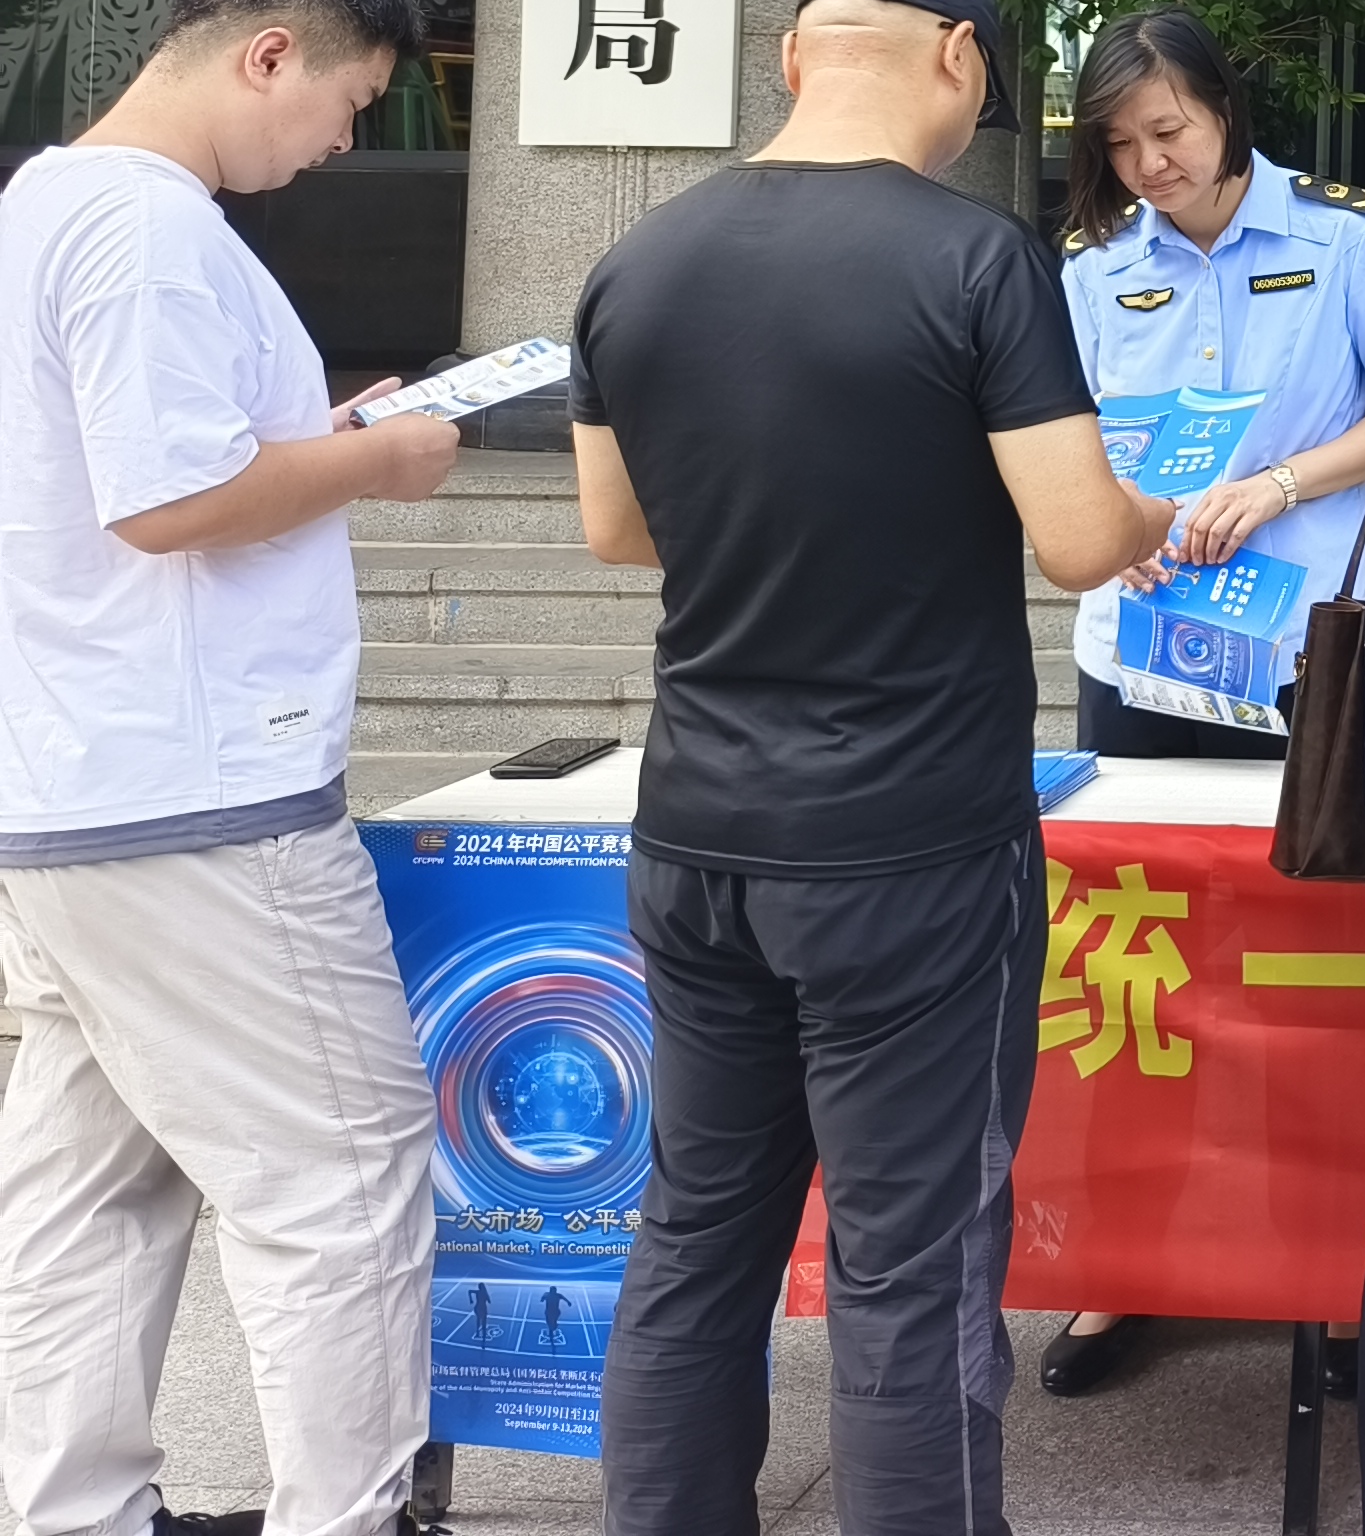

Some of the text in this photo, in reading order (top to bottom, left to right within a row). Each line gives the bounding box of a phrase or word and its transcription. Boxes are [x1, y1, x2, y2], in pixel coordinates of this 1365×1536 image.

[453, 855, 481, 867] 2024
[482, 856, 514, 867] CHINA
[516, 856, 537, 867] FAIR
[538, 857, 607, 867] COMPETITION
[541, 1242, 564, 1254] Fair
[504, 1418, 551, 1432] September
